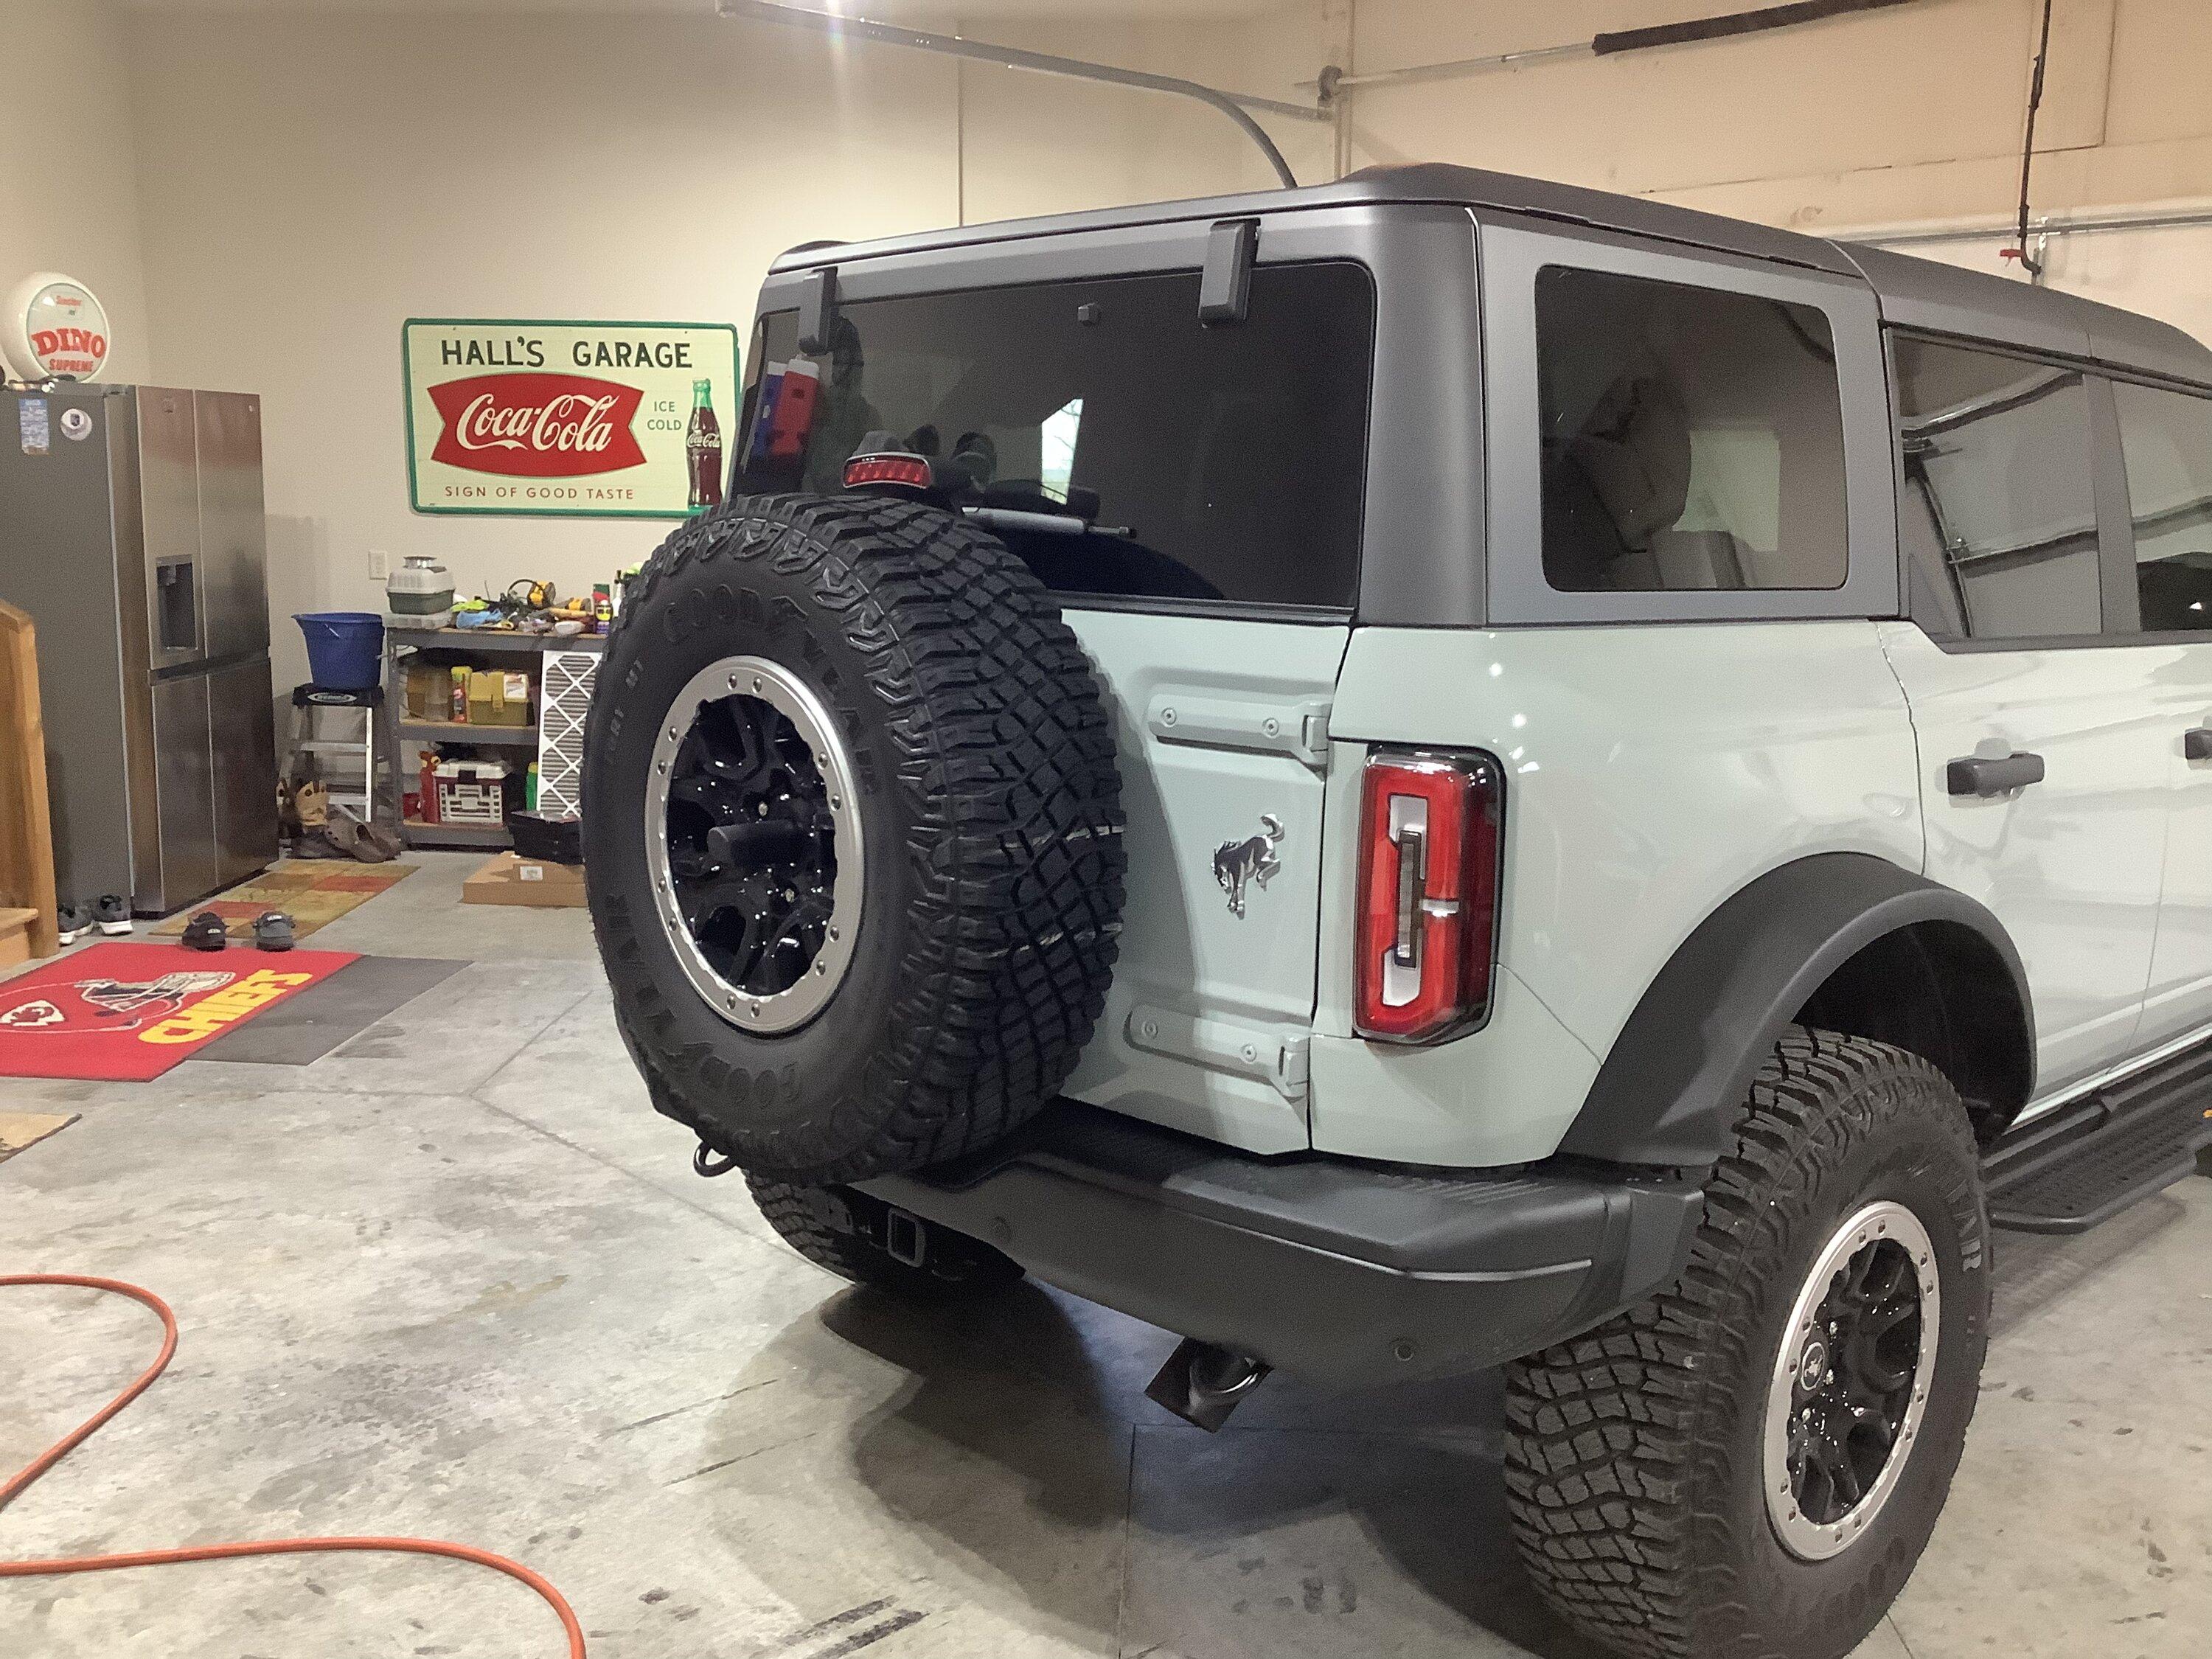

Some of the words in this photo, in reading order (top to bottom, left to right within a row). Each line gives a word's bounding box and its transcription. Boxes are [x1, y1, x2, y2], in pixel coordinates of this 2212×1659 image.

[32, 328, 105, 358] DINO
[442, 336, 544, 367] HALL'S
[573, 341, 692, 368] GARAGE
[654, 401, 675, 412] ICE
[456, 393, 619, 452] Coca-Cola
[647, 419, 681, 431] COLD
[445, 486, 486, 497] SIGN
[496, 487, 517, 498] OF
[526, 487, 577, 499] GOOD
[587, 488, 633, 500] TASTE
[138, 969, 313, 1044] CHIEFS
